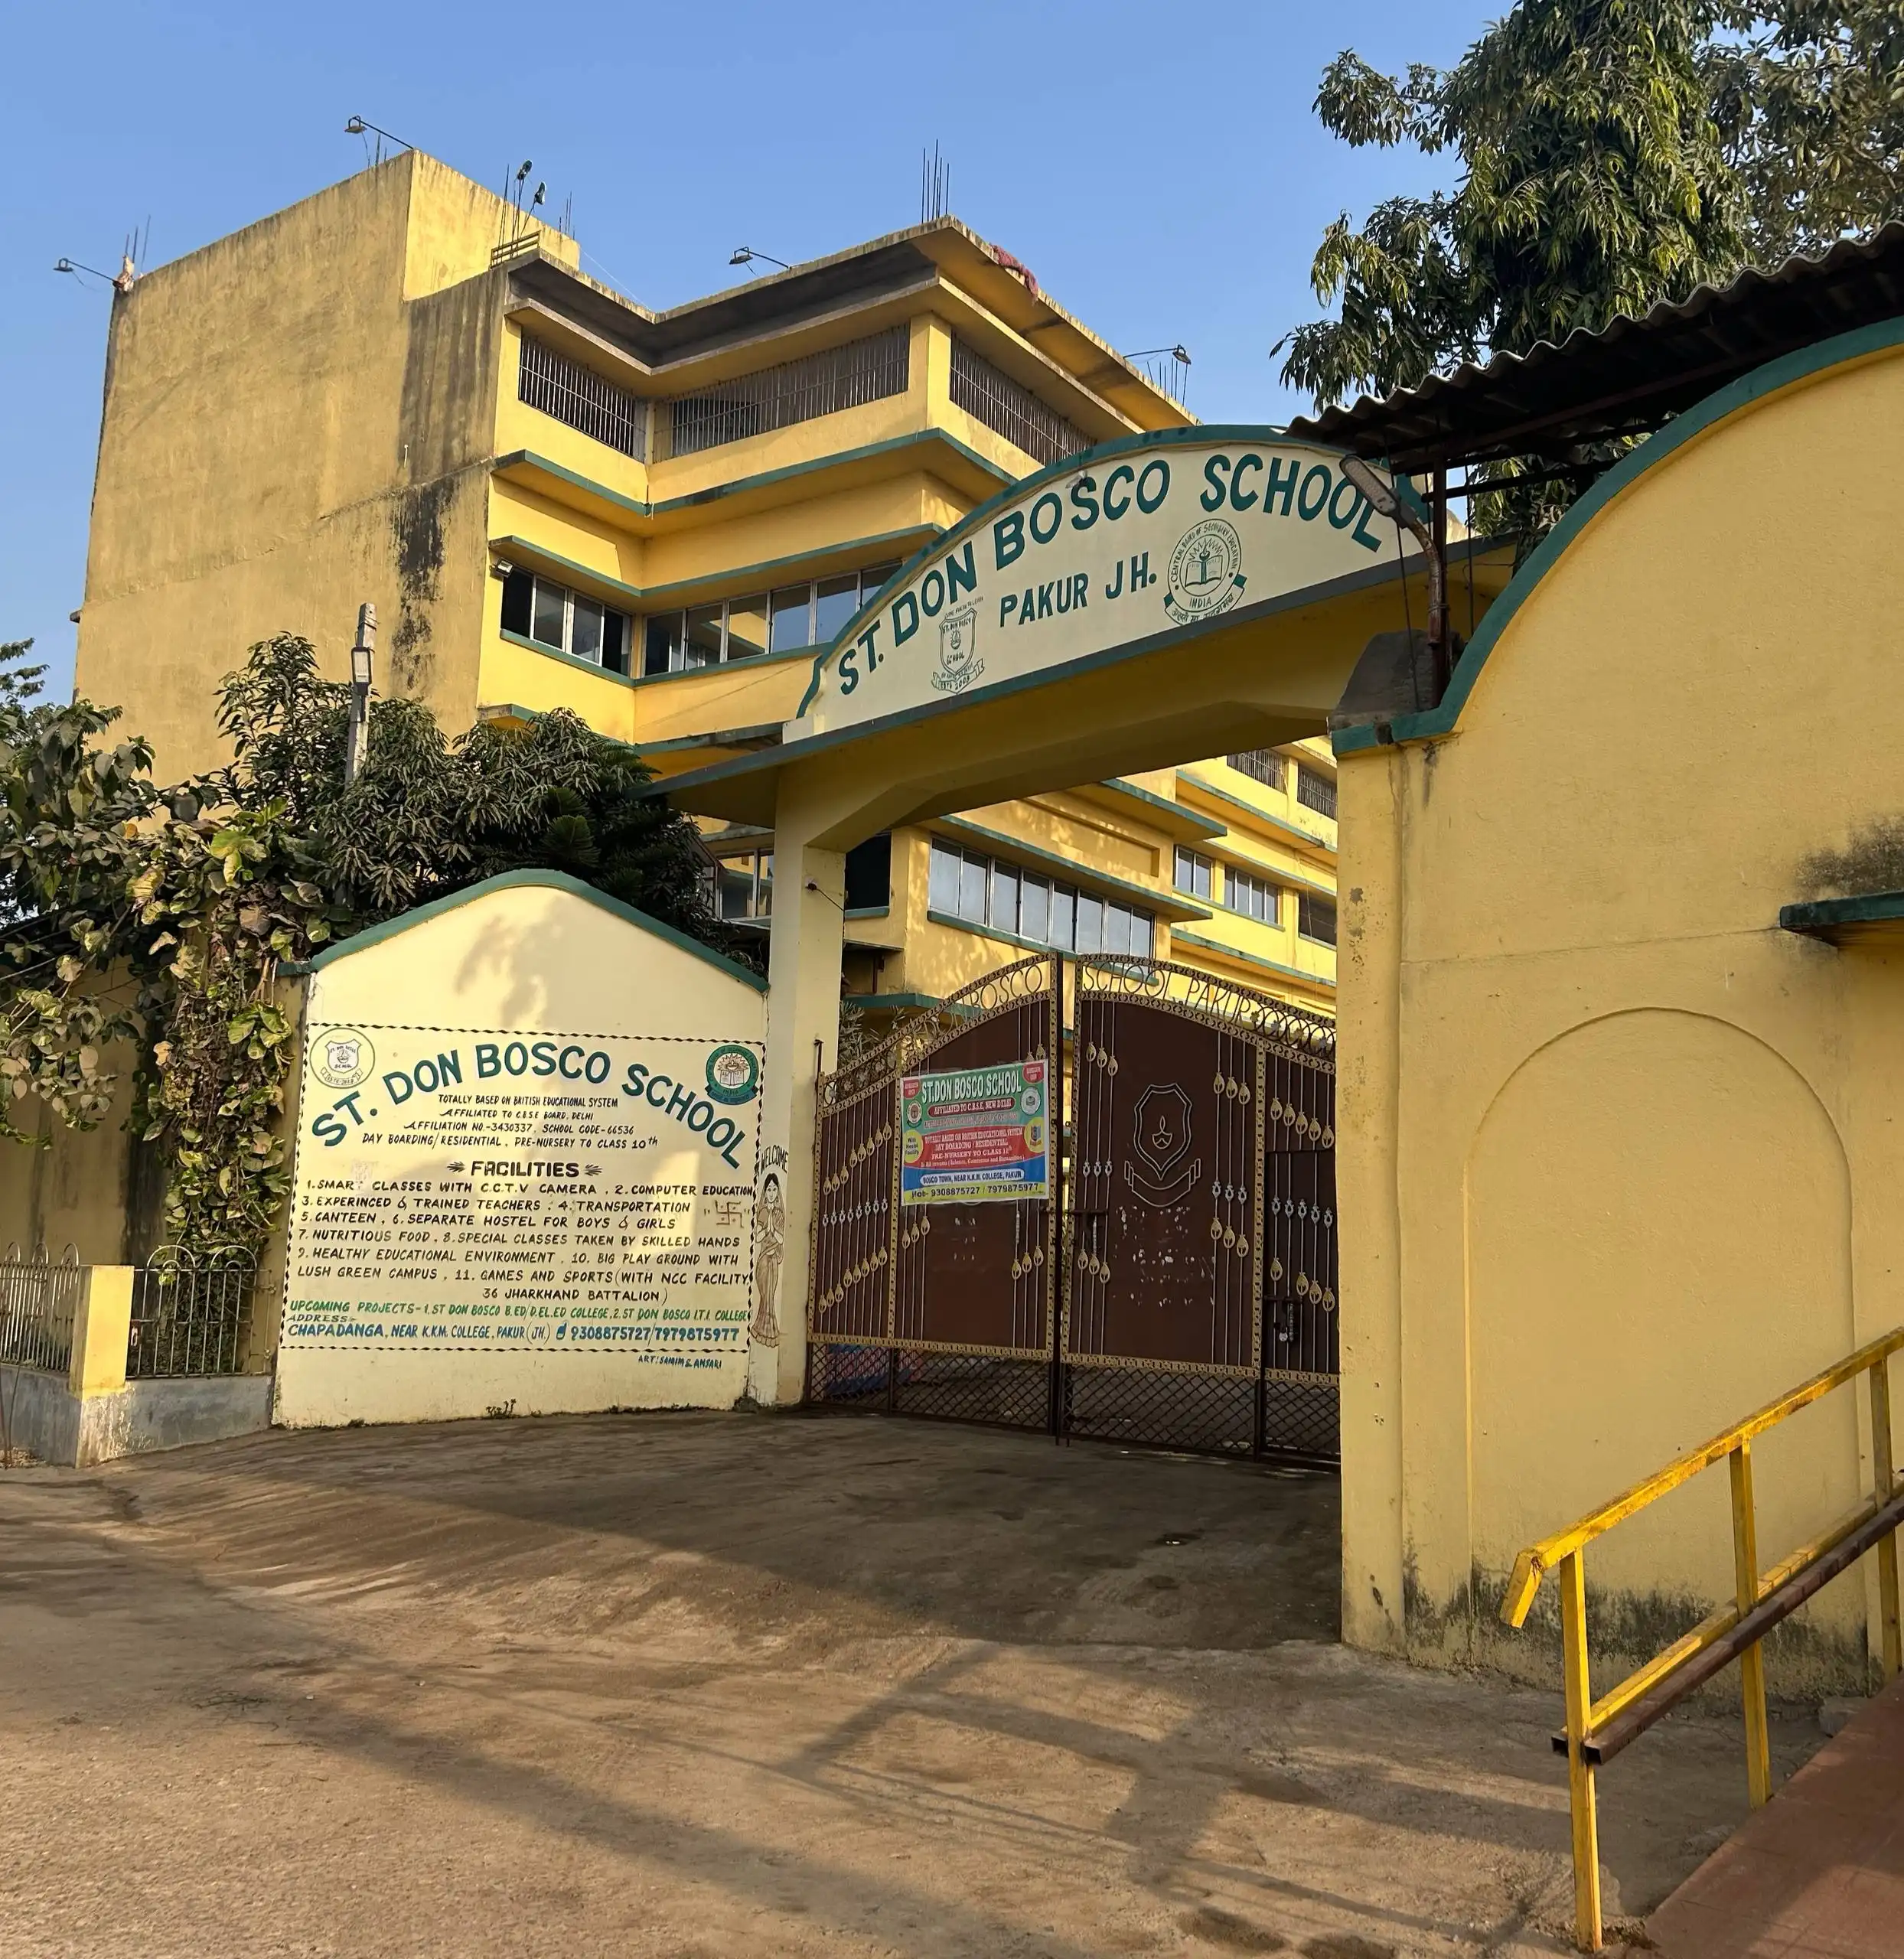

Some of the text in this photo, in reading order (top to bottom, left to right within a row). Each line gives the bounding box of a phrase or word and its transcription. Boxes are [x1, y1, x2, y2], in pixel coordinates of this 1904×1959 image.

[839, 454, 1381, 695] ST. DON BOSCO SCHOOL
[1000, 573, 1088, 627] PAKUR
[1189, 597, 1211, 608] INDIA
[955, 1075, 983, 1099] BOSCO
[986, 1070, 1022, 1096] SCHOOL
[312, 1041, 746, 1169] ST. DON BOSCO SCHOOL
[439, 1094, 618, 1108] TOTALLY BASED ON BRITISH EDUCATIONAL SYSTEM
[440, 1109, 497, 1118] AFFILIATED
[572, 1112, 594, 1121] DELHI
[404, 1121, 467, 1130] AFFILIATION
[543, 1124, 573, 1133] SCHOOL
[362, 1133, 383, 1143] DAY
[515, 1136, 575, 1148] PRE-NURSERY
[580, 1139, 591, 1148] TO
[598, 1139, 627, 1149] CLASS
[632, 1136, 658, 1149] 10th
[976, 1138, 1008, 1148] RESIDENTIAL
[761, 1145, 788, 1175] WELCOME
[931, 1151, 971, 1159] PRE-NURSERY
[471, 1160, 579, 1177] FACILITIES
[982, 1172, 1004, 1181] COLLEGE,
[373, 1181, 431, 1191] CLASSES
[440, 1182, 472, 1193] WITH
[703, 1185, 753, 1196] EDUCATION
[931, 1187, 980, 1196] 9308875727
[988, 1183, 1038, 1193] 7979875977
[397, 1196, 406, 1211] &
[414, 1198, 470, 1209] TRAINED
[484, 1215, 536, 1227] HOSTEL
[544, 1217, 568, 1227] FOR
[577, 1217, 610, 1229] BOYS
[618, 1216, 628, 1231] &
[637, 1218, 676, 1230] GIRLS
[513, 1234, 567, 1245] CLASSES
[575, 1234, 614, 1247] TAKEN
[621, 1236, 636, 1247] BY
[642, 1236, 691, 1247] SKILLED
[698, 1237, 740, 1247] HANDS
[377, 1248, 457, 1262] EDUCATIONAL
[598, 1253, 615, 1264] BIG
[623, 1253, 650, 1265] PLAY
[657, 1253, 700, 1266] GROUND
[709, 1254, 738, 1266] WITH
[298, 1266, 331, 1277] LUSH
[337, 1267, 382, 1279] GREEN
[481, 1270, 523, 1281] GAMES
[530, 1271, 555, 1283] AND
[661, 1272, 687, 1284] NCC
[482, 1288, 497, 1299] 36
[505, 1289, 579, 1300] JHARKHAND
[290, 1301, 350, 1312] UPCOMING
[448, 1304, 468, 1315] DON
[471, 1304, 500, 1316] BOSCO
[638, 1309, 658, 1319] DON
[663, 1309, 690, 1320] BOSCO
[715, 1310, 748, 1322] COLLEGE
[391, 1325, 418, 1338] NEAR
[693, 1358, 722, 1369] ANSARI
